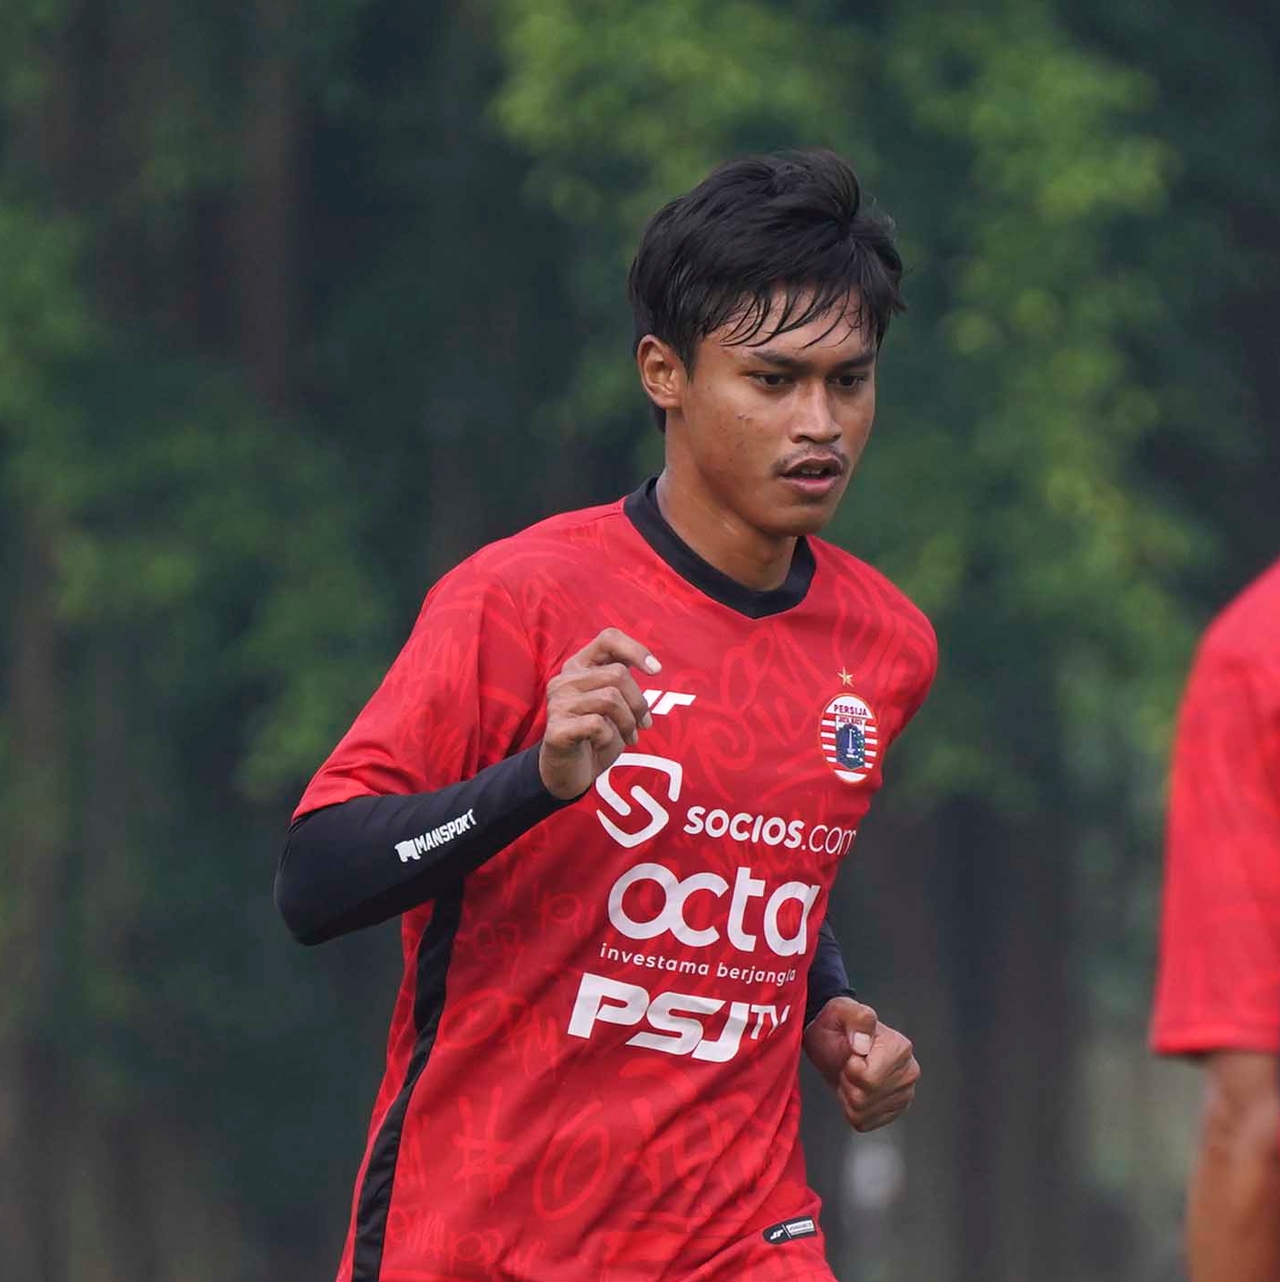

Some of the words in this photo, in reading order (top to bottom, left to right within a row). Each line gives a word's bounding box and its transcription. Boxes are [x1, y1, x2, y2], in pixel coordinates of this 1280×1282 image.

[833, 704, 868, 716] PERSIJA
[414, 808, 477, 854] MANSPORT
[607, 862, 821, 956] octa
[599, 943, 709, 975] investama
